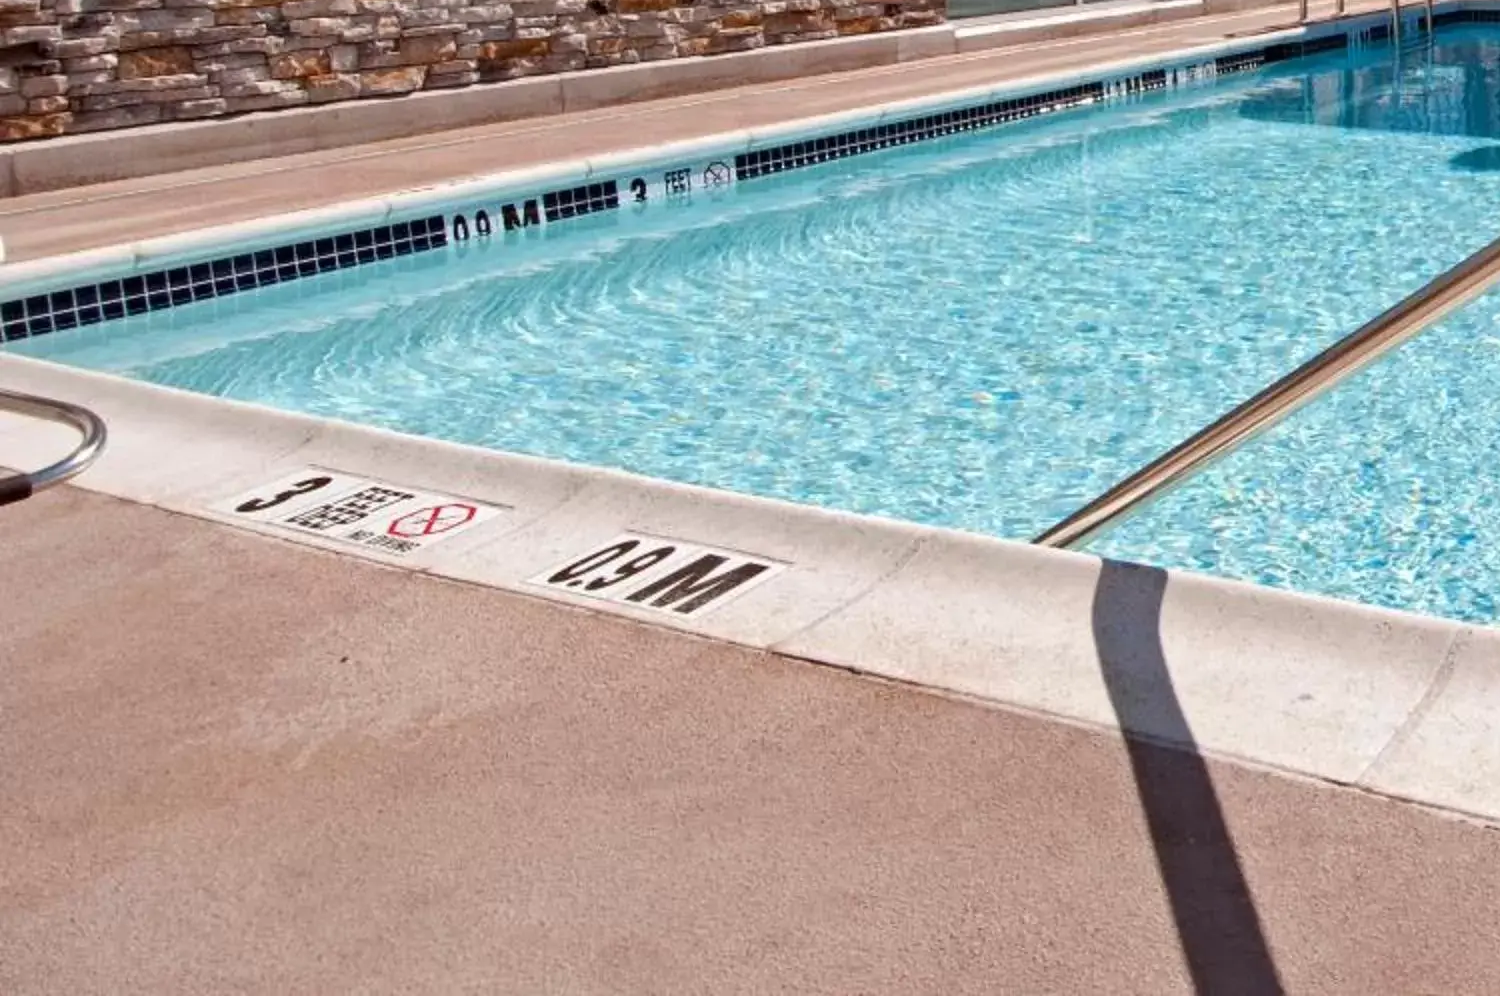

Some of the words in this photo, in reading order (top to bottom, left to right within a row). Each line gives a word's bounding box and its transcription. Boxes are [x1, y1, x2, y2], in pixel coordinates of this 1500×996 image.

[665, 168, 691, 194] FEET
[502, 199, 540, 231] M
[235, 476, 333, 512] 3
[333, 486, 415, 513] FEET
[286, 504, 369, 531] DEEP
[548, 539, 676, 591] 0.9
[625, 553, 770, 614] M
